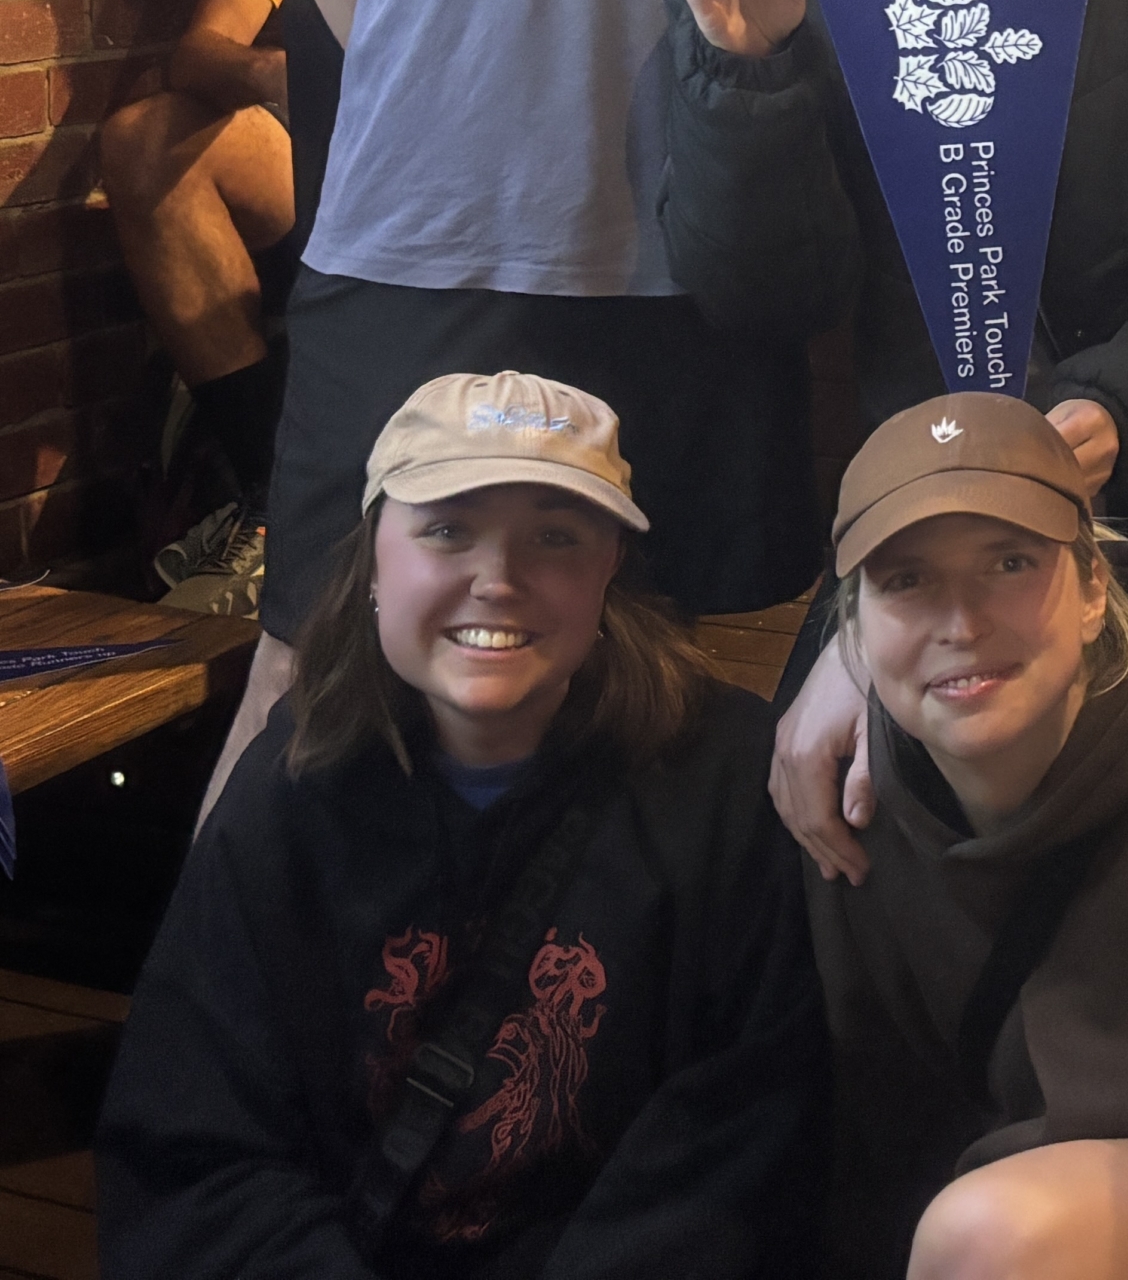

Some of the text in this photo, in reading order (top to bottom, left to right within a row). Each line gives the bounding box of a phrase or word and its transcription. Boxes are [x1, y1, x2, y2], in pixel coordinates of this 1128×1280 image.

[939, 144, 977, 378] B Grade Premiers
[969, 140, 1012, 389] Princes Park Touch
